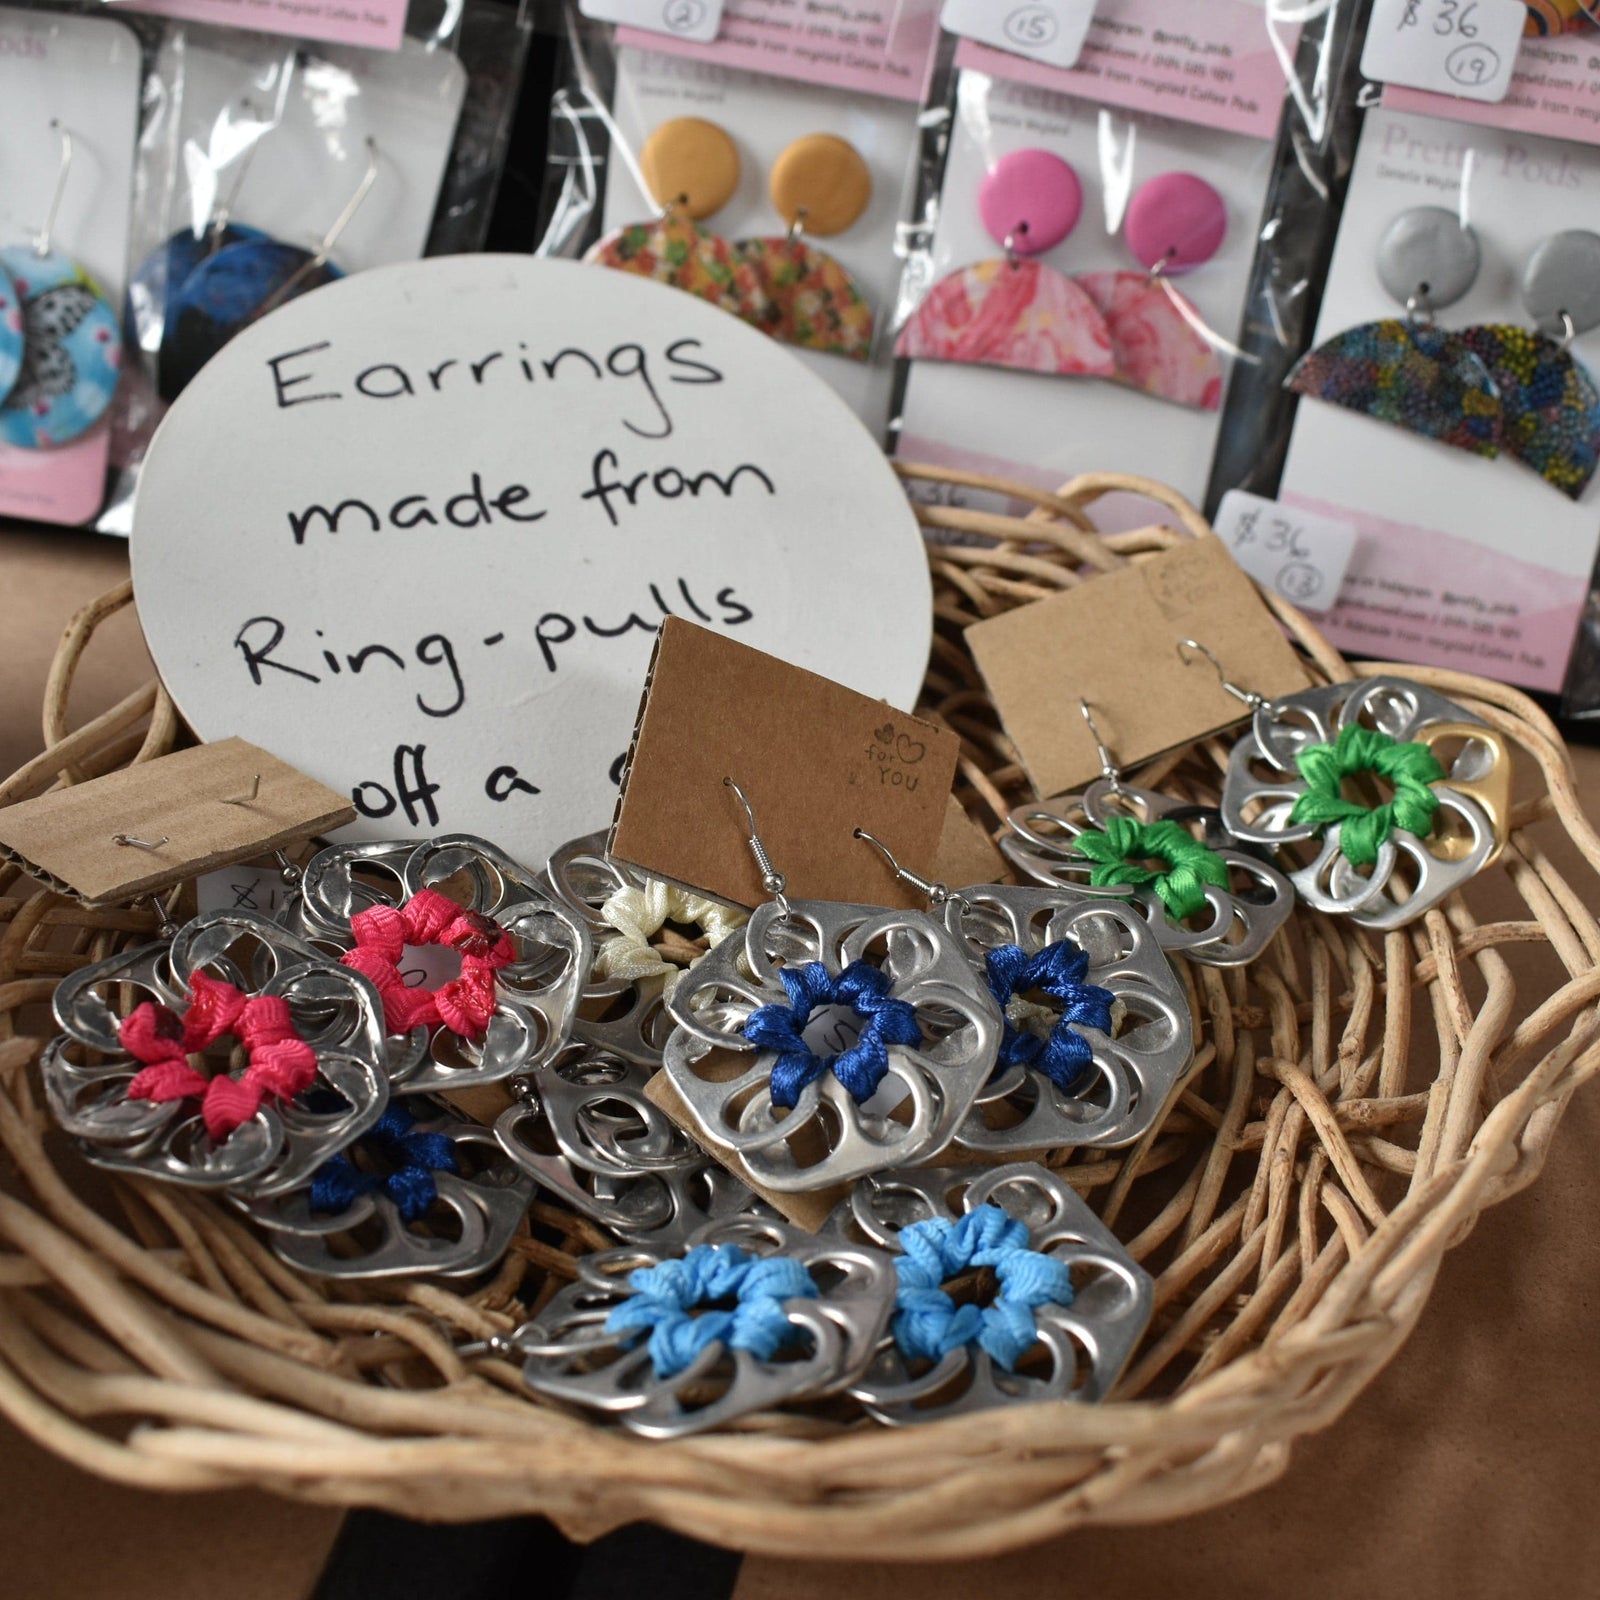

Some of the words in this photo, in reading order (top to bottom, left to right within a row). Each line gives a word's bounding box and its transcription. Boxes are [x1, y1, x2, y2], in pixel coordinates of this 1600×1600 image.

[267, 339, 723, 437] Earrings
[287, 472, 547, 545] made
[581, 448, 775, 526] from
[352, 743, 441, 828] off
[484, 765, 541, 803] a
[864, 743, 895, 762] for
